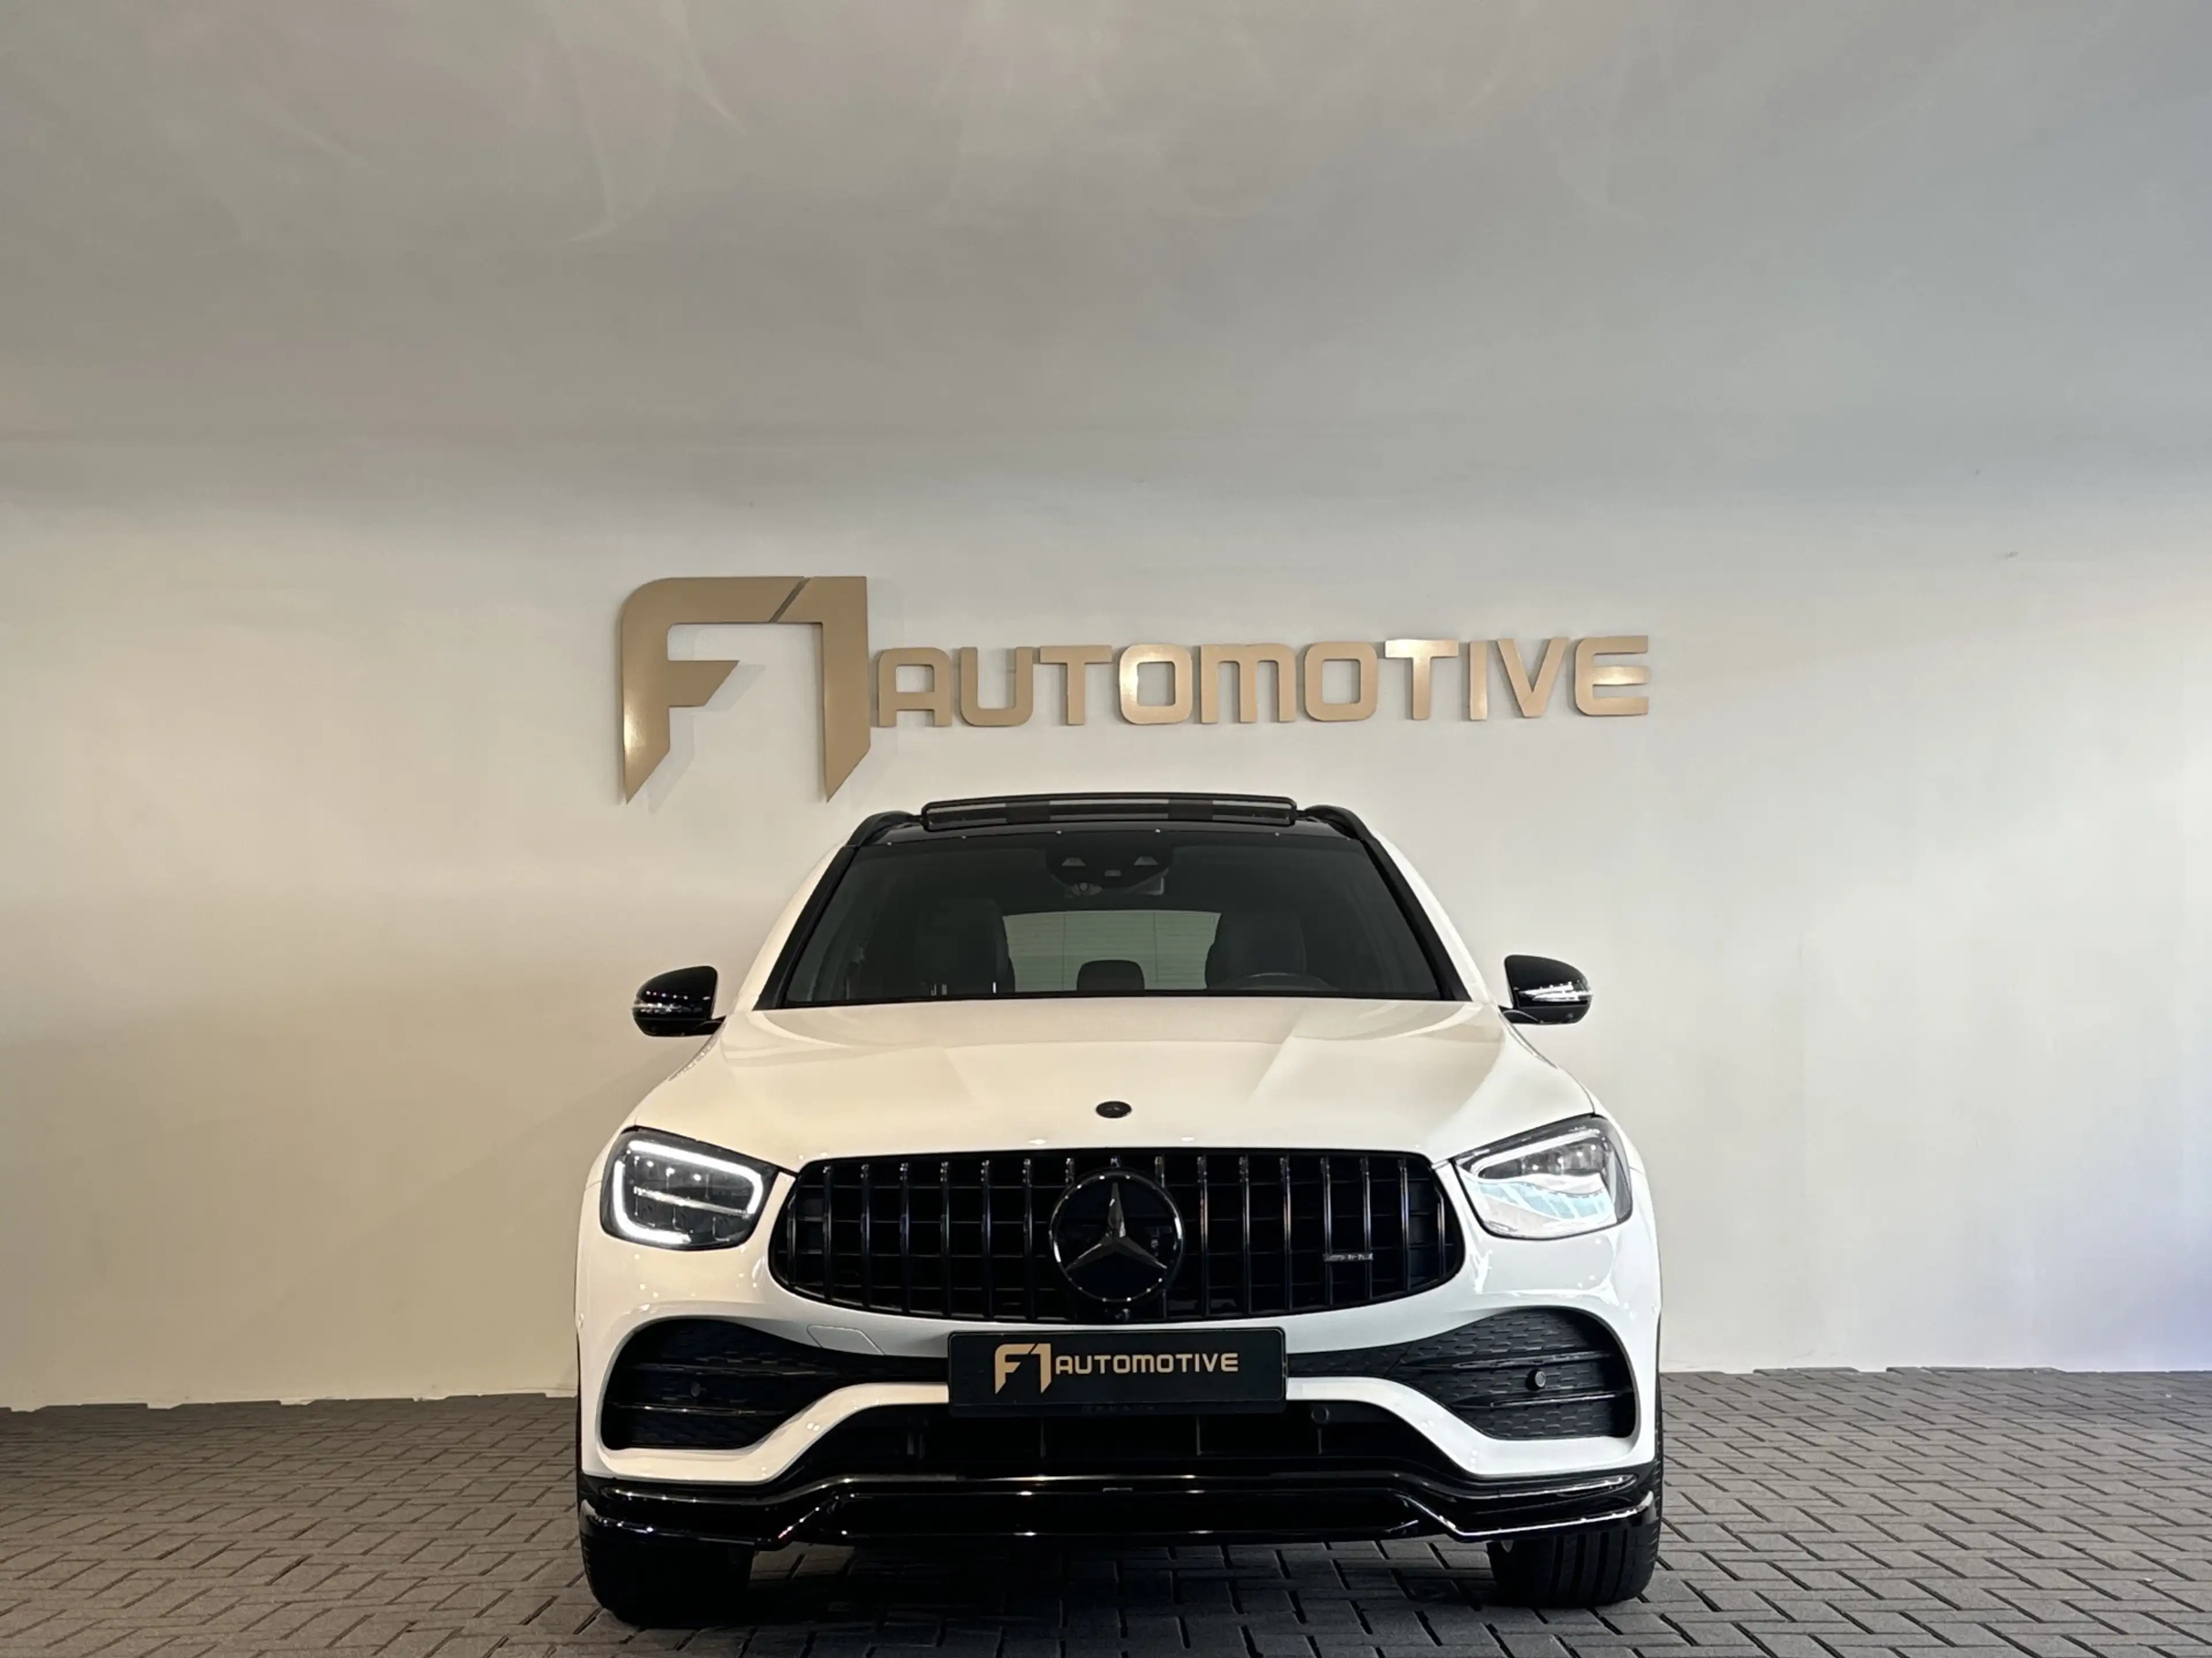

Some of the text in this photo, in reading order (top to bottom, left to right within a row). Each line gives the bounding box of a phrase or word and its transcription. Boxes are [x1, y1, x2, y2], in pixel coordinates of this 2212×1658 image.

[621, 576, 1650, 804] F1 AUTOMOTIVE
[994, 1343, 1239, 1394] F1 AUTOMOTIVE
